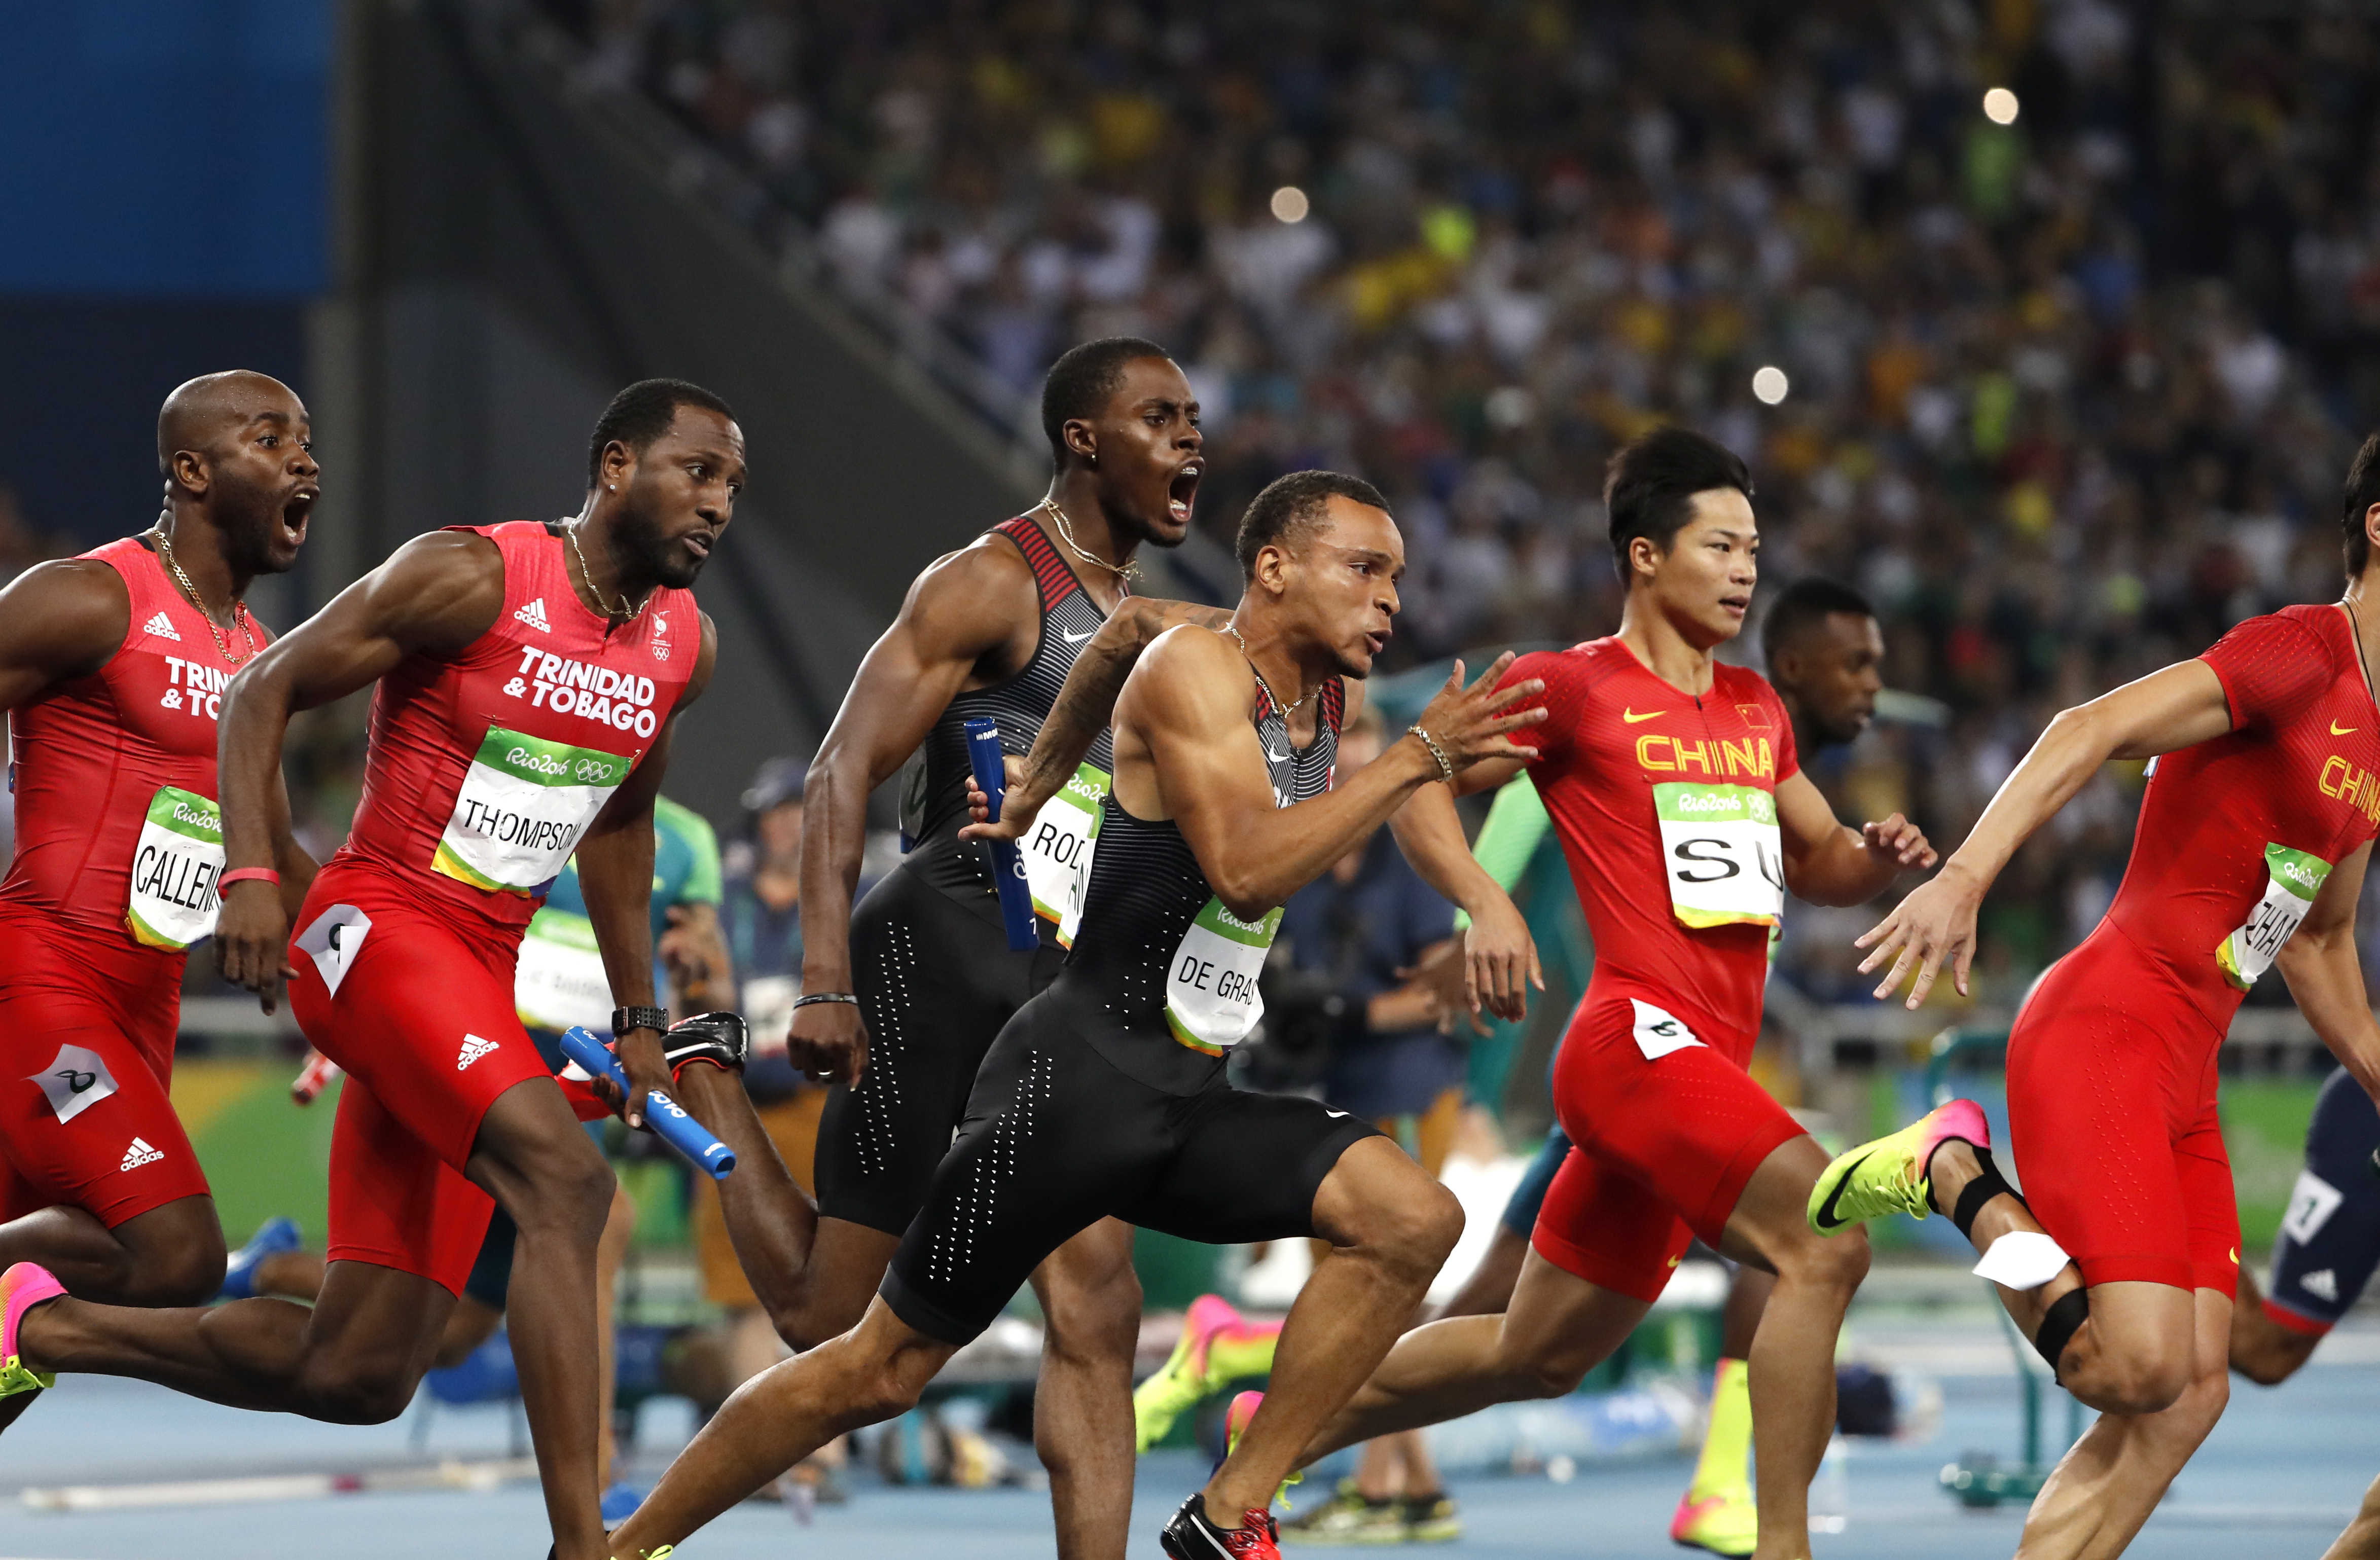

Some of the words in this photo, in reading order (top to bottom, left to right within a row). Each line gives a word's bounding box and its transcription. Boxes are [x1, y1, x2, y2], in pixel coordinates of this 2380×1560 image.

[143, 624, 181, 642] adidas
[514, 610, 551, 633] adidas
[165, 656, 235, 695] TRIN
[518, 645, 655, 707] TRINIDAD
[160, 688, 183, 710] &
[503, 677, 527, 698] &
[532, 679, 656, 738] TOBAGO
[506, 747, 571, 775] Rio2016
[1636, 735, 1774, 781] CHINA
[1678, 793, 1742, 812] Rio2016
[464, 799, 582, 851] THOMPSON
[136, 846, 220, 913] CALLEN
[1675, 839, 1784, 892] SU
[1178, 956, 1214, 991] DE
[457, 1041, 500, 1071] adidas
[120, 1150, 165, 1172] adidas
